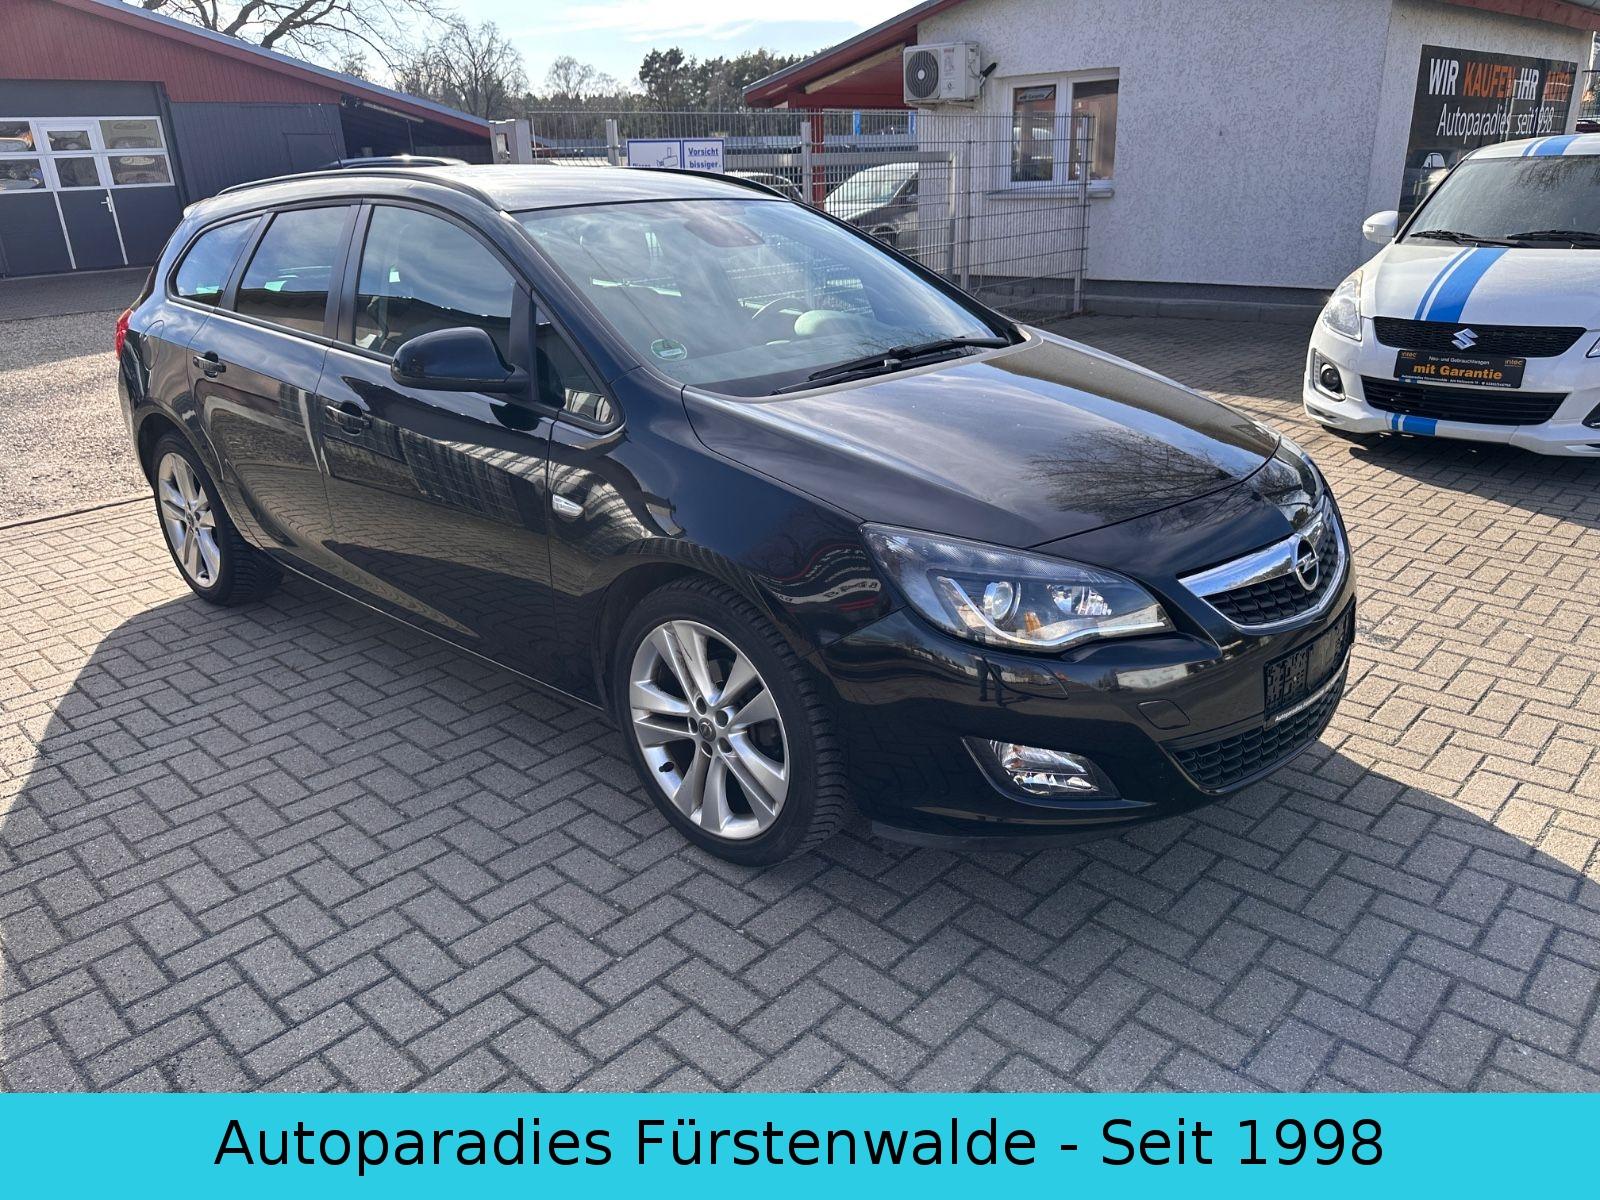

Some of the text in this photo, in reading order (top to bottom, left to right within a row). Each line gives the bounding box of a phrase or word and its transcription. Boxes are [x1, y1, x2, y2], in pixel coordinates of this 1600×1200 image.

[1428, 58, 1459, 96] WIR
[1462, 61, 1516, 99] KAUFEN
[1517, 67, 1540, 101] IHR
[1436, 103, 1511, 145] Autoparadies
[688, 147, 719, 156] Vorsicht
[689, 160, 718, 170] bissiger
[1413, 363, 1503, 380] mit Garantie
